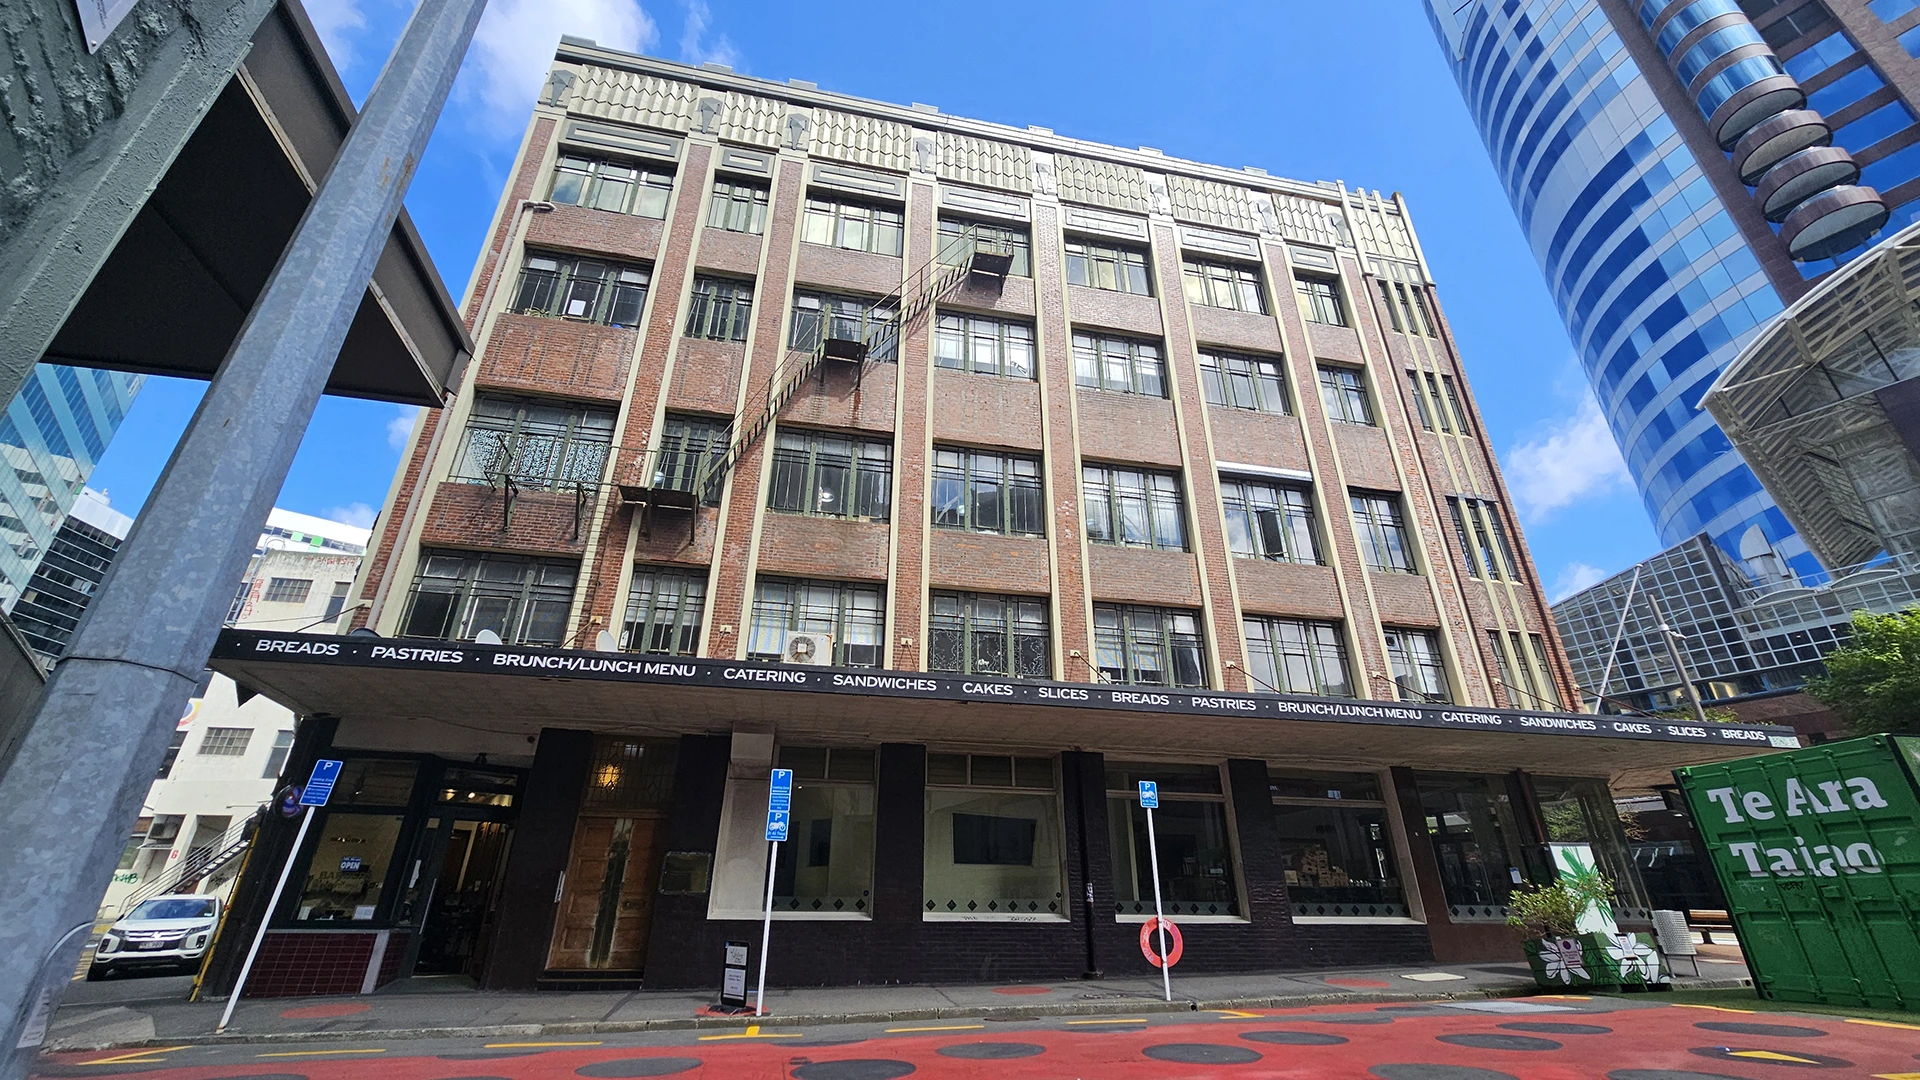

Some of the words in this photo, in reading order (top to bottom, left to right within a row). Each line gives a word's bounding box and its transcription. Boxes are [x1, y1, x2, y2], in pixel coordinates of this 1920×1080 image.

[255, 638, 341, 656] BREADS
[370, 646, 464, 663] PASTRIES
[492, 653, 641, 674] BRUNCH/LUNCH
[644, 663, 697, 677] MENU
[723, 667, 806, 683] CATERING
[832, 674, 937, 691] SANDWICHES
[962, 682, 1013, 696] CAKES
[1038, 687, 1089, 700] SLICES
[1111, 692, 1170, 705] BREADS
[1191, 697, 1256, 711] PASTRIES
[1278, 702, 1384, 718] BRUNCH/LUNCH
[1385, 708, 1423, 720] MENU
[1441, 712, 1502, 724] CATERING
[1520, 717, 1597, 730] SANDWICHES
[1613, 722, 1652, 734] CAKES
[1668, 725, 1707, 738] SLICES
[1721, 729, 1767, 741] BREADS
[323, 762, 333, 770] P
[778, 771, 785, 779] P
[1706, 787, 1776, 823] Te
[1786, 776, 1888, 817] Ara
[775, 812, 782, 821] P
[1728, 836, 1886, 877] Taiao
[340, 861, 360, 870] OPEN
